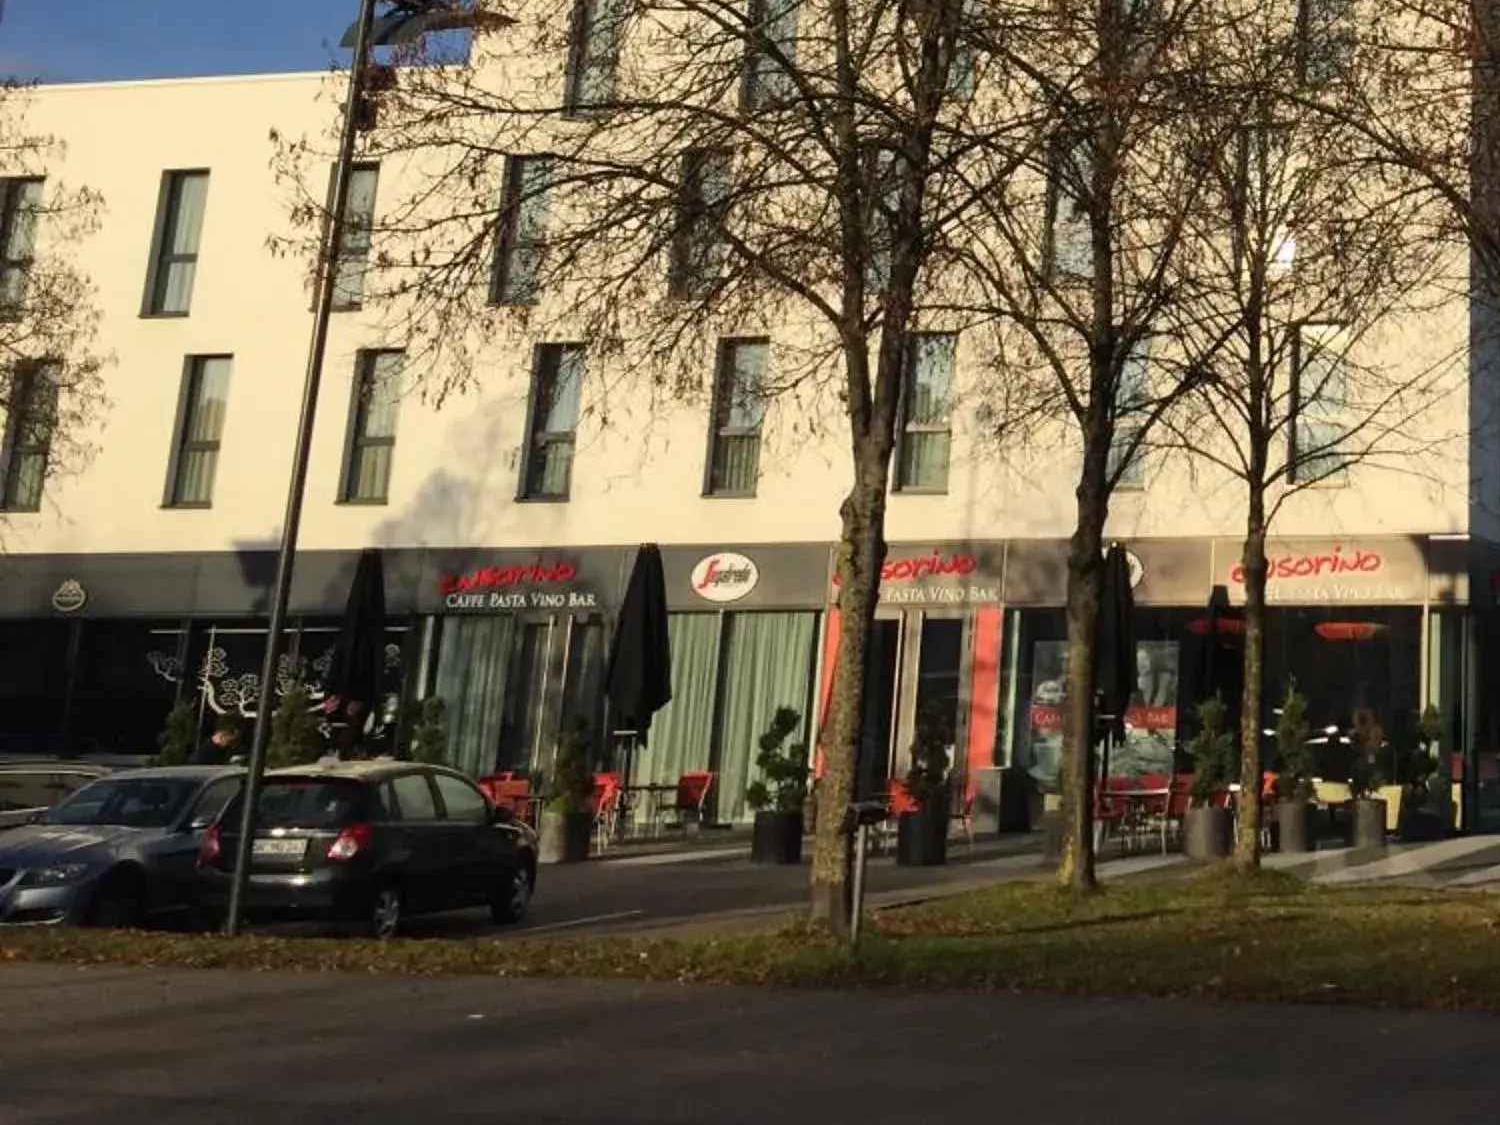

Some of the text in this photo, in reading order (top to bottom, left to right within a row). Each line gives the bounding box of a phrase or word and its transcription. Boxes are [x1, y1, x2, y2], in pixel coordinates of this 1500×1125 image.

[489, 592, 527, 608] PASTA
[530, 592, 566, 607] VINO
[568, 592, 597, 607] BAR
[928, 586, 965, 602] VINO
